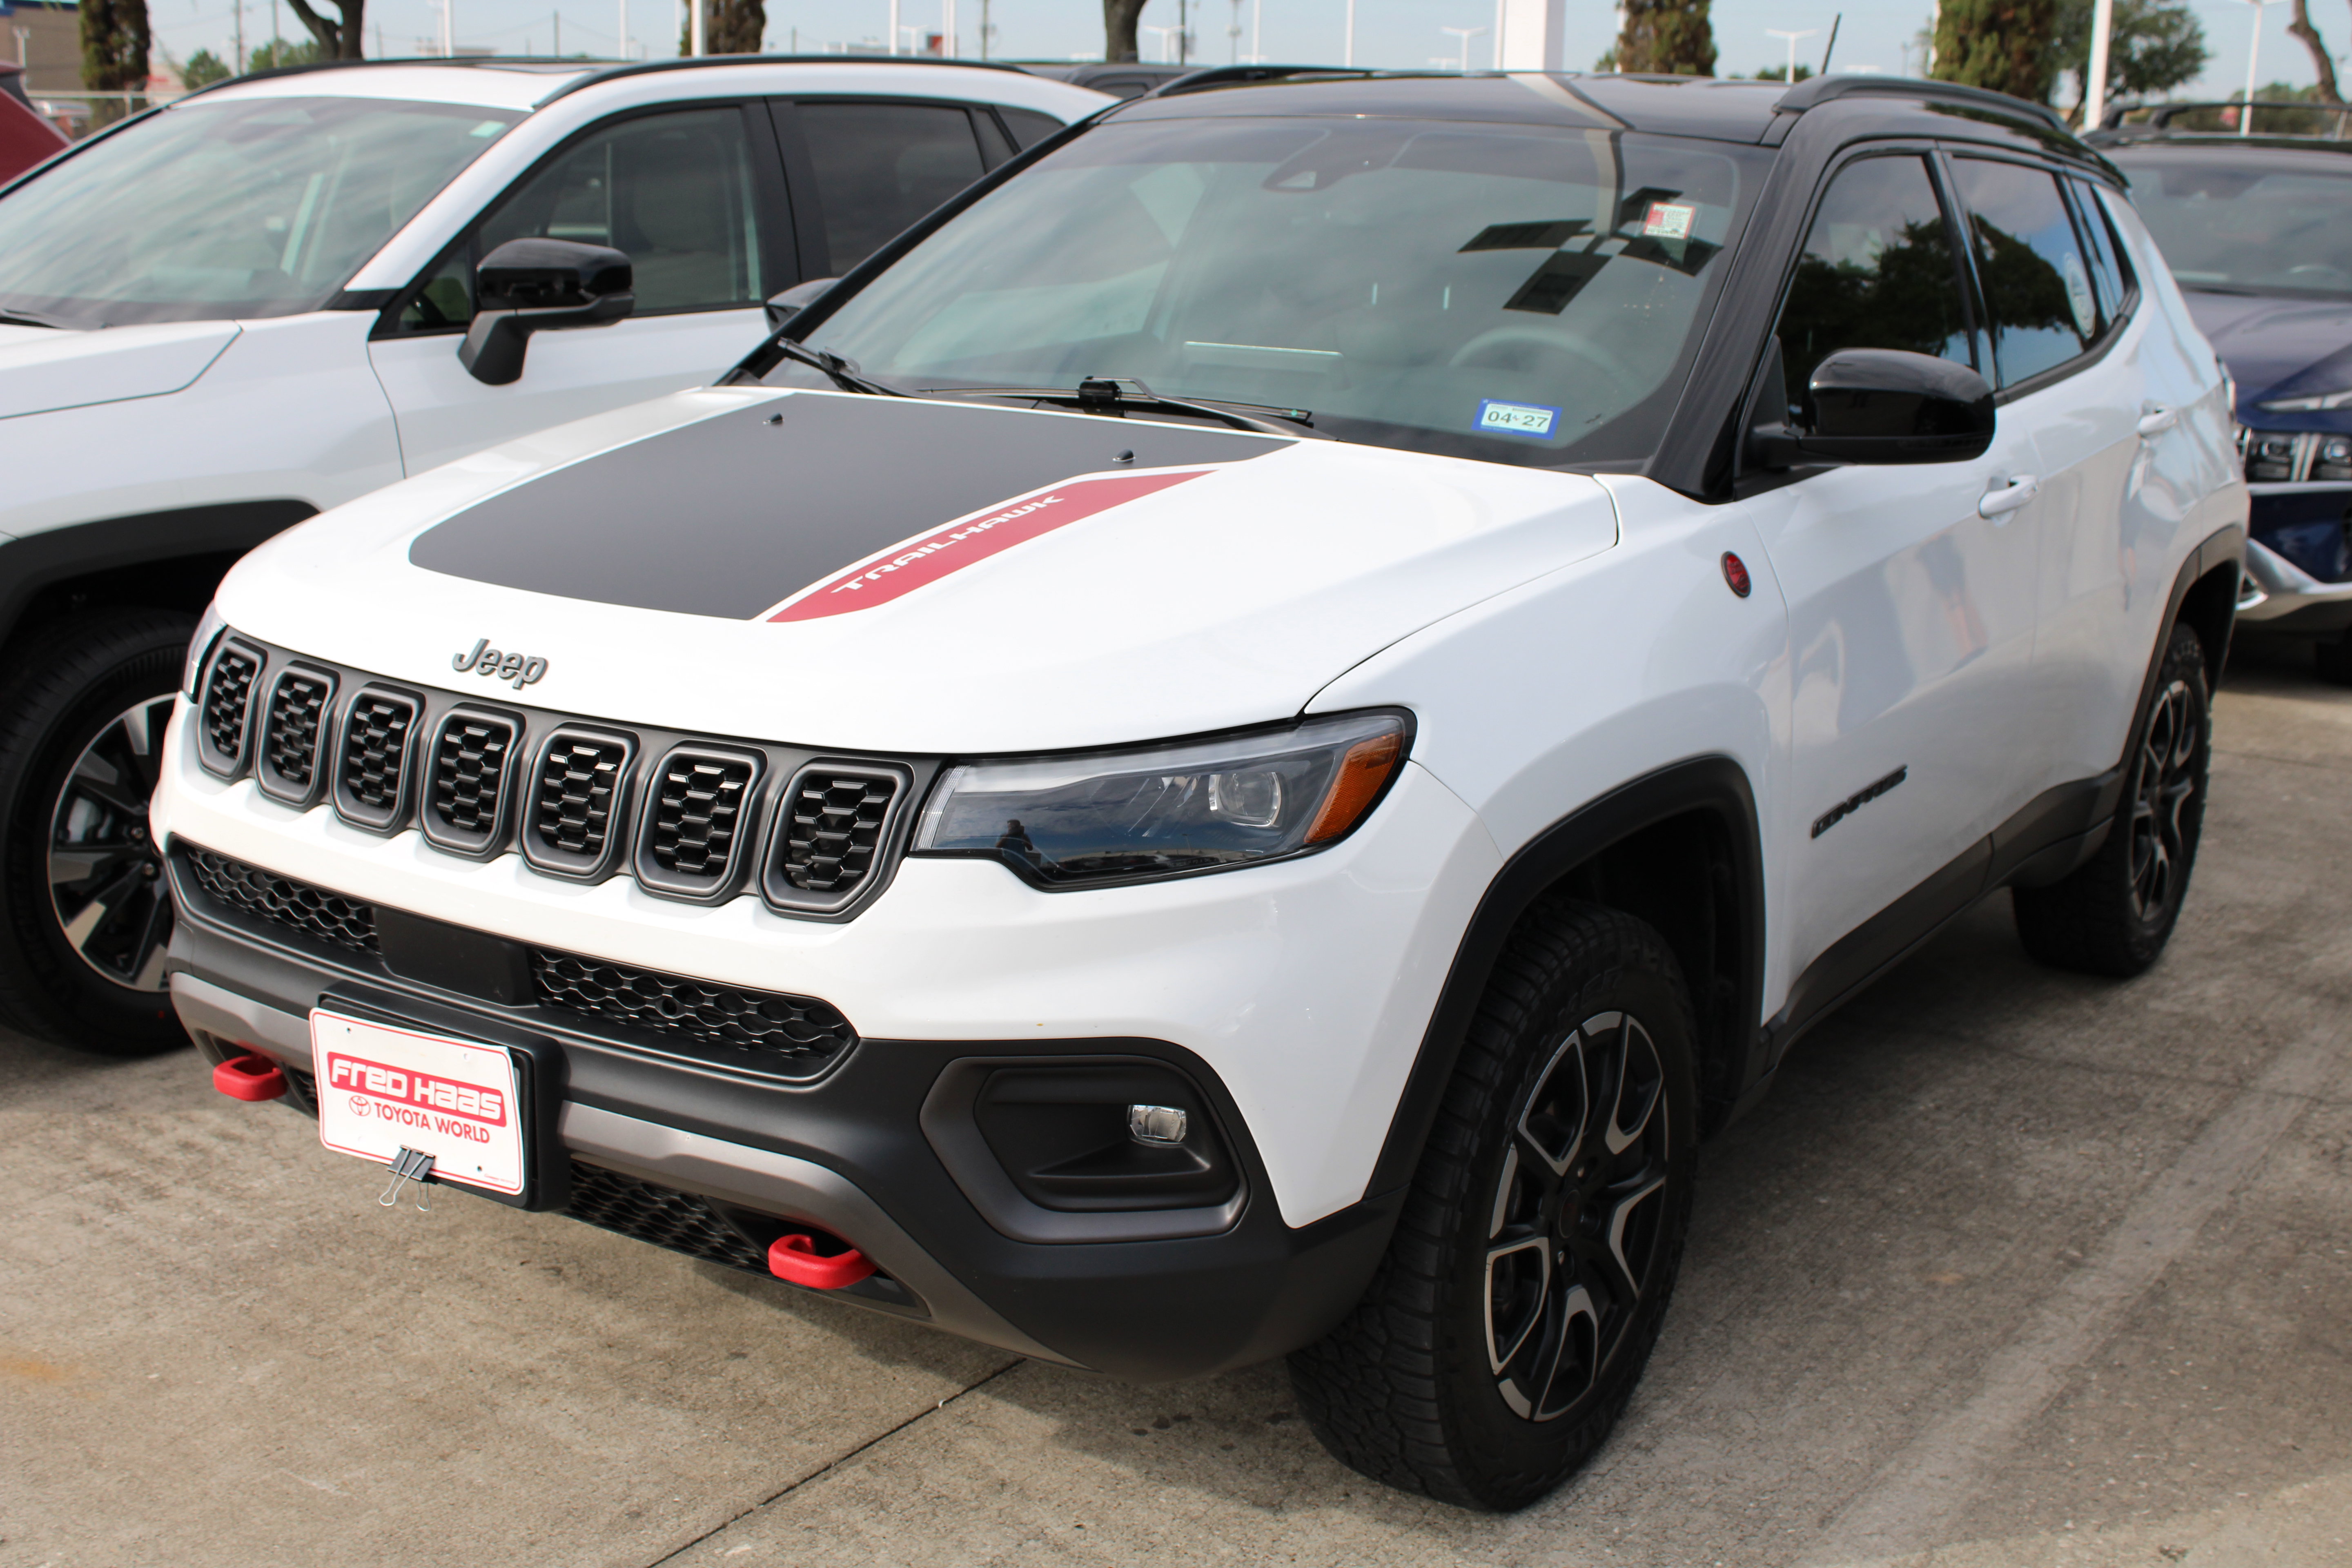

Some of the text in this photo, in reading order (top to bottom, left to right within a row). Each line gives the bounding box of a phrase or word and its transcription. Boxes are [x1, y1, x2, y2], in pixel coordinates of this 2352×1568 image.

[1488, 410, 1512, 423] 04
[1522, 414, 1549, 428] 27
[830, 495, 1065, 593] TRAILHAWK
[452, 638, 548, 690] Jeep
[374, 1102, 490, 1144] TOYOTA WORLD
